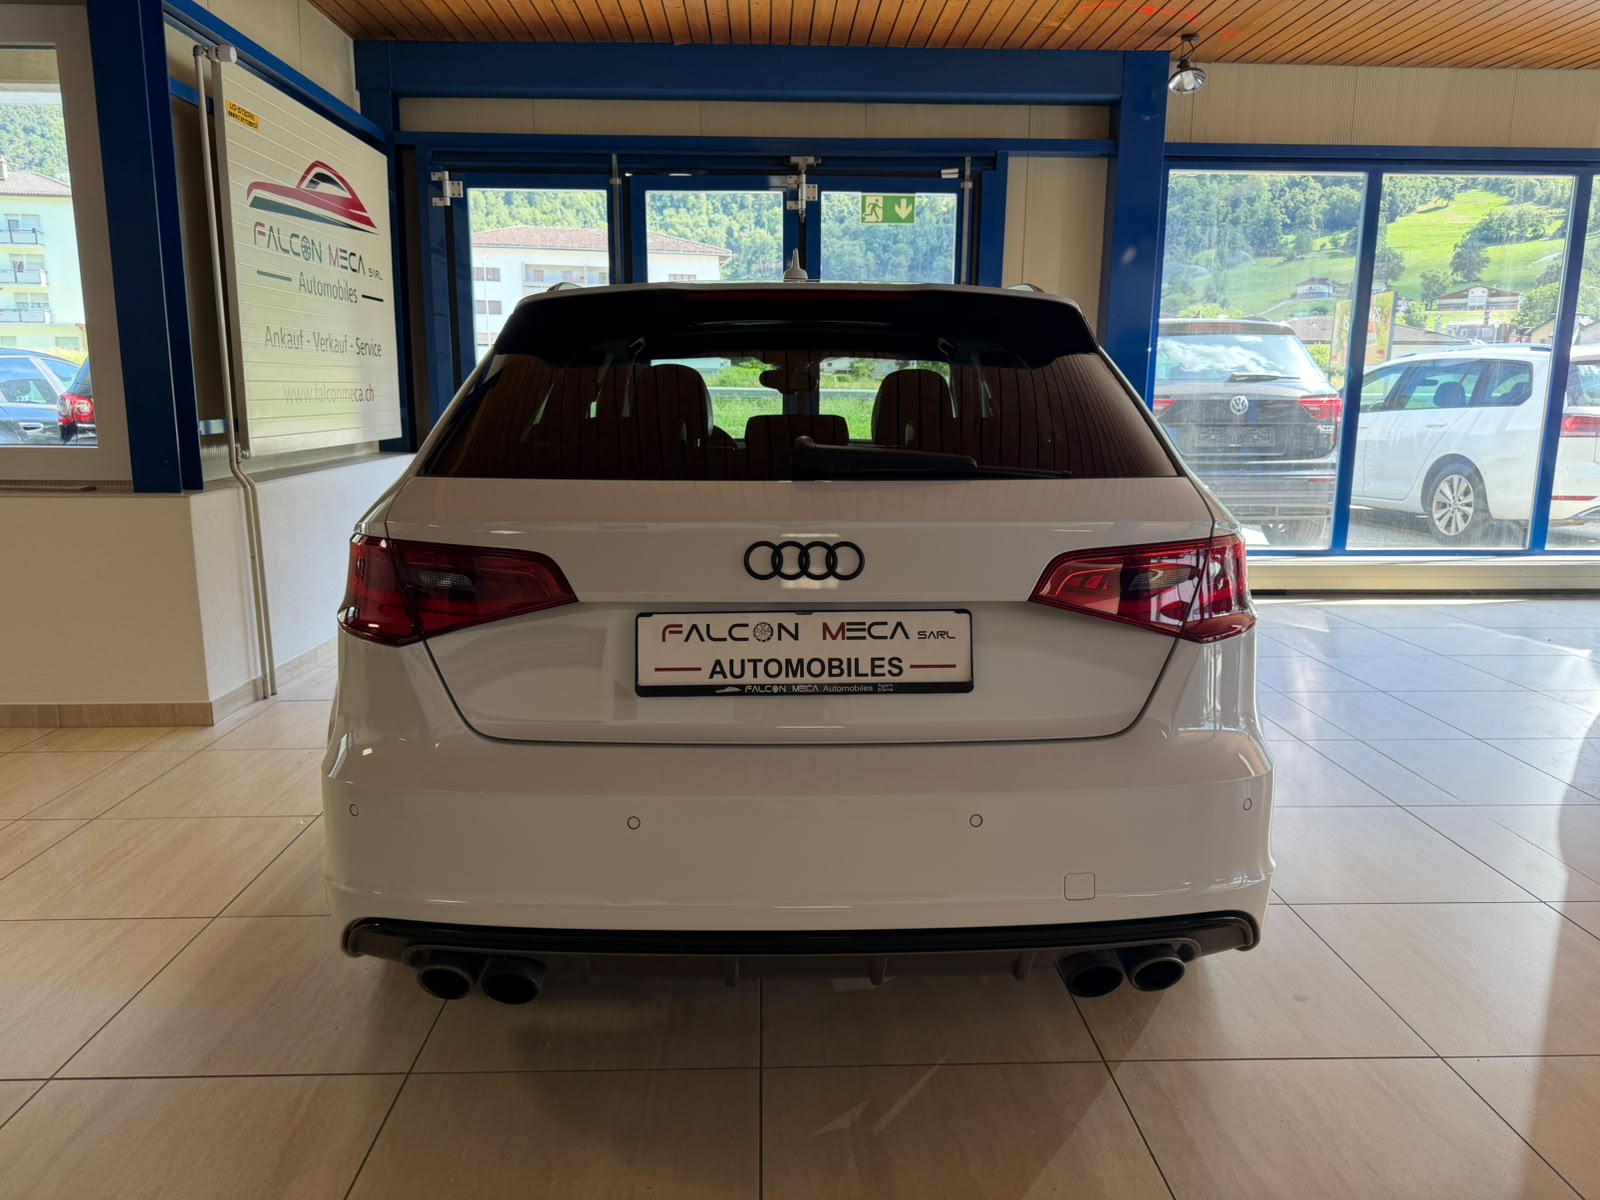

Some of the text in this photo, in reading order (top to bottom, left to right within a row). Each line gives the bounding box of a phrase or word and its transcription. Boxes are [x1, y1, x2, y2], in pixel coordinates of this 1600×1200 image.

[253, 221, 323, 263] FALCON
[328, 244, 366, 276] MECA
[298, 271, 358, 304] Automobiles
[264, 325, 304, 350] Ankauf
[312, 330, 348, 355] Verkauf
[355, 336, 382, 358] Service
[283, 381, 375, 404] www.falconmeca.ch
[661, 621, 956, 643] FALCON MECA SARL
[708, 656, 904, 679] AUTOMOBILES
[744, 684, 787, 694] FALCON
[791, 684, 819, 693] MECA
[822, 684, 874, 693] Automobiles
